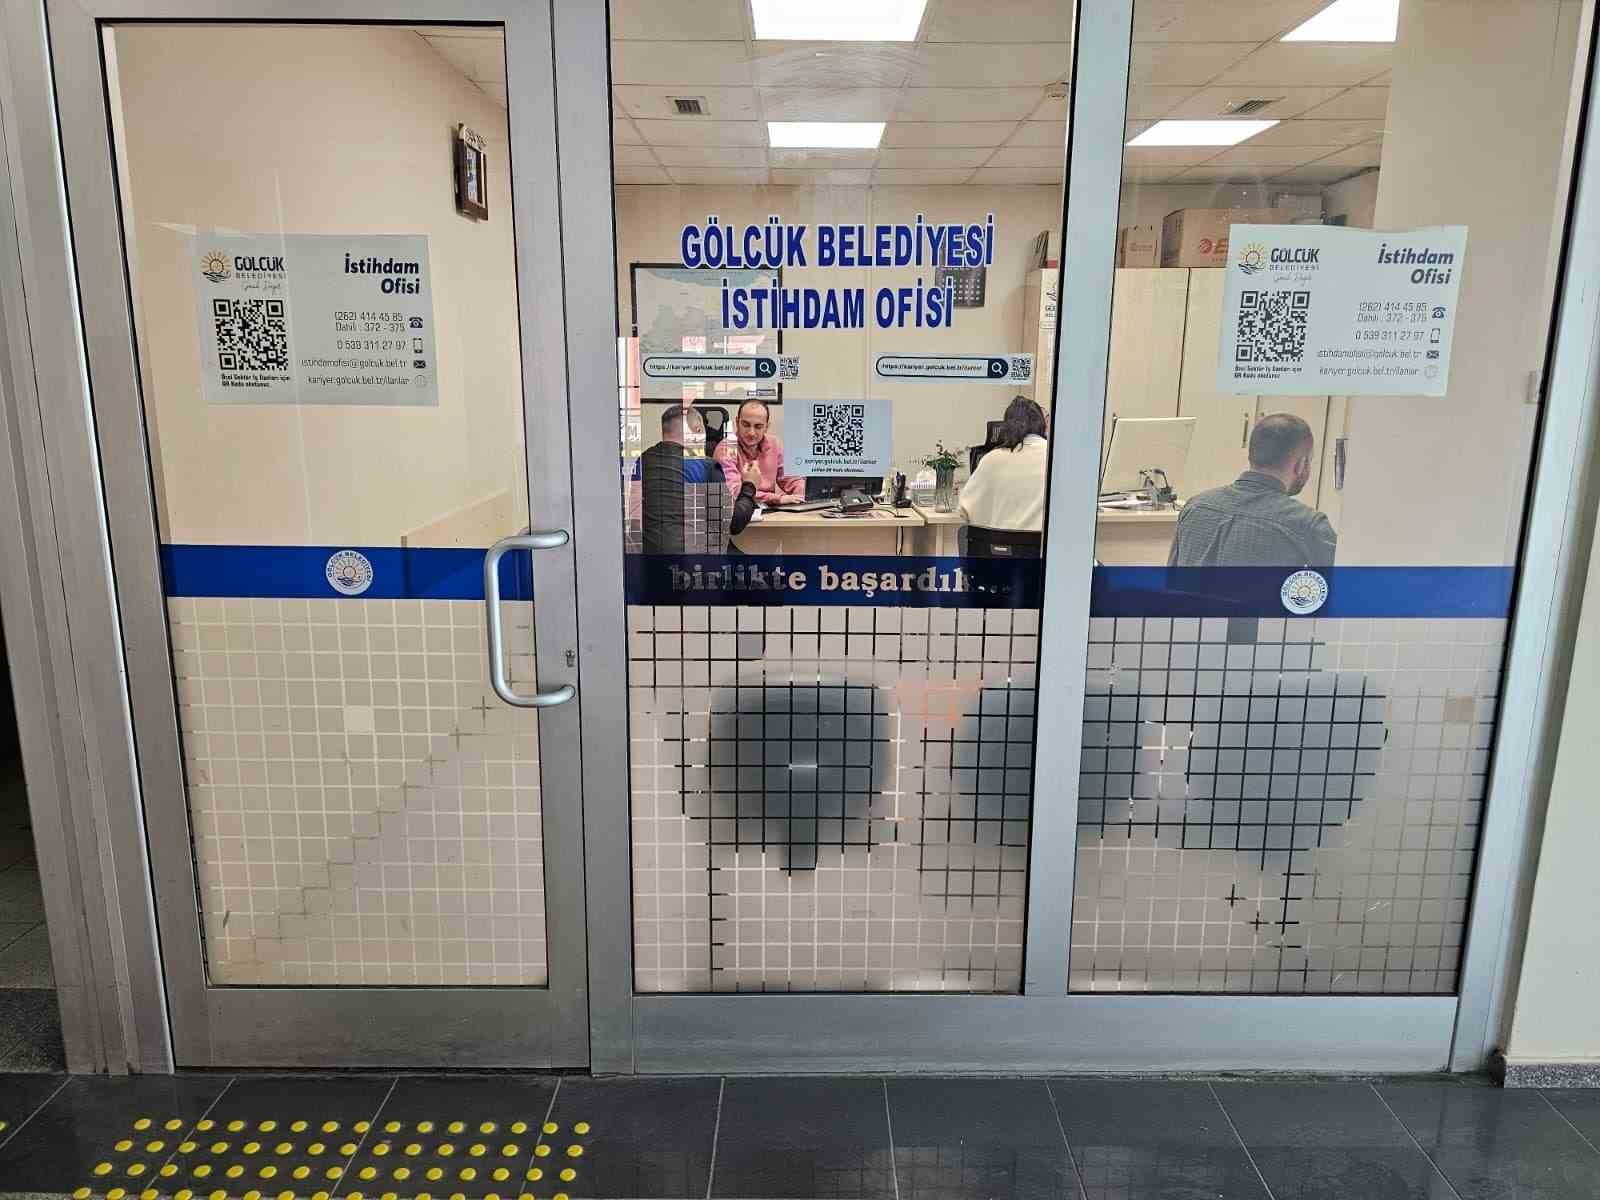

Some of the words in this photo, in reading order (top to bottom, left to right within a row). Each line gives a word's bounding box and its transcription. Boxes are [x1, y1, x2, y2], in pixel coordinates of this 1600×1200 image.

[681, 216, 808, 268] GÖLCÜK
[817, 213, 994, 268] BELEDİYESİ
[1377, 243, 1455, 265] İstihdam
[344, 252, 420, 274] İstihdam
[1410, 268, 1453, 284] Ofisi
[381, 277, 420, 294] Ofisi
[722, 277, 866, 329] İSTİHDAM
[875, 276, 954, 329] OFİSİ
[1359, 302, 1382, 312] (262)
[1383, 302, 1401, 312] 414
[1402, 302, 1414, 312] 45
[1416, 302, 1428, 312] 85
[334, 311, 357, 321] (262)
[360, 311, 376, 321] 414
[379, 312, 390, 322] 45
[364, 322, 381, 332] 372
[390, 323, 405, 332] 375
[1355, 330, 1361, 340] 0
[1363, 330, 1380, 340] 539
[1381, 331, 1397, 341] 311
[1400, 331, 1411, 341] 27
[1413, 331, 1424, 340] 97
[337, 340, 343, 350] 0
[364, 340, 379, 350] 311
[382, 340, 393, 350] 27
[671, 564, 807, 592] birlikte
